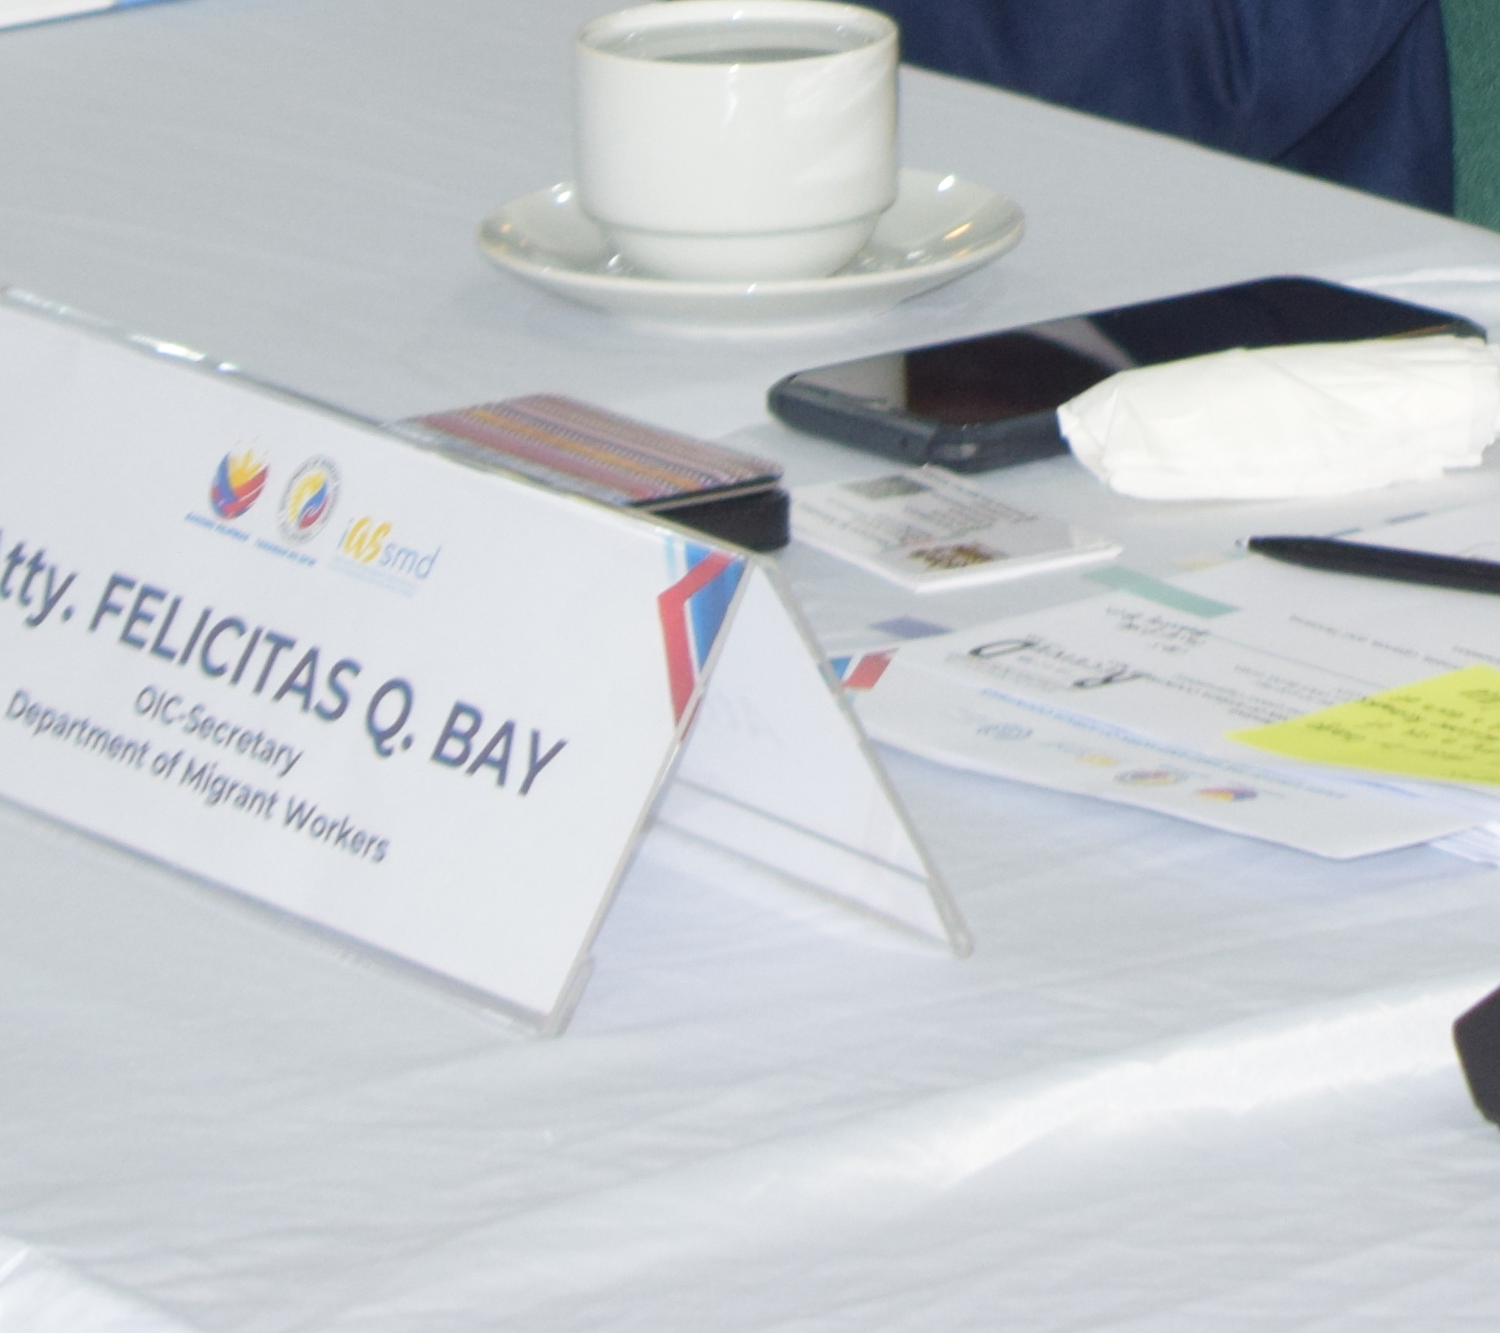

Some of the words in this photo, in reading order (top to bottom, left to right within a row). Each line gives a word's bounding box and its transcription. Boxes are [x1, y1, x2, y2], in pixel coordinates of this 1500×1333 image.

[86, 572, 363, 723] FELICITAS
[364, 675, 414, 758] Q.
[429, 700, 568, 797] BAY
[134, 683, 305, 778] OIC-Secretary
[4, 688, 151, 769] Department
[151, 746, 181, 779] of
[179, 756, 279, 820] Migrant
[282, 794, 392, 864] Workers
